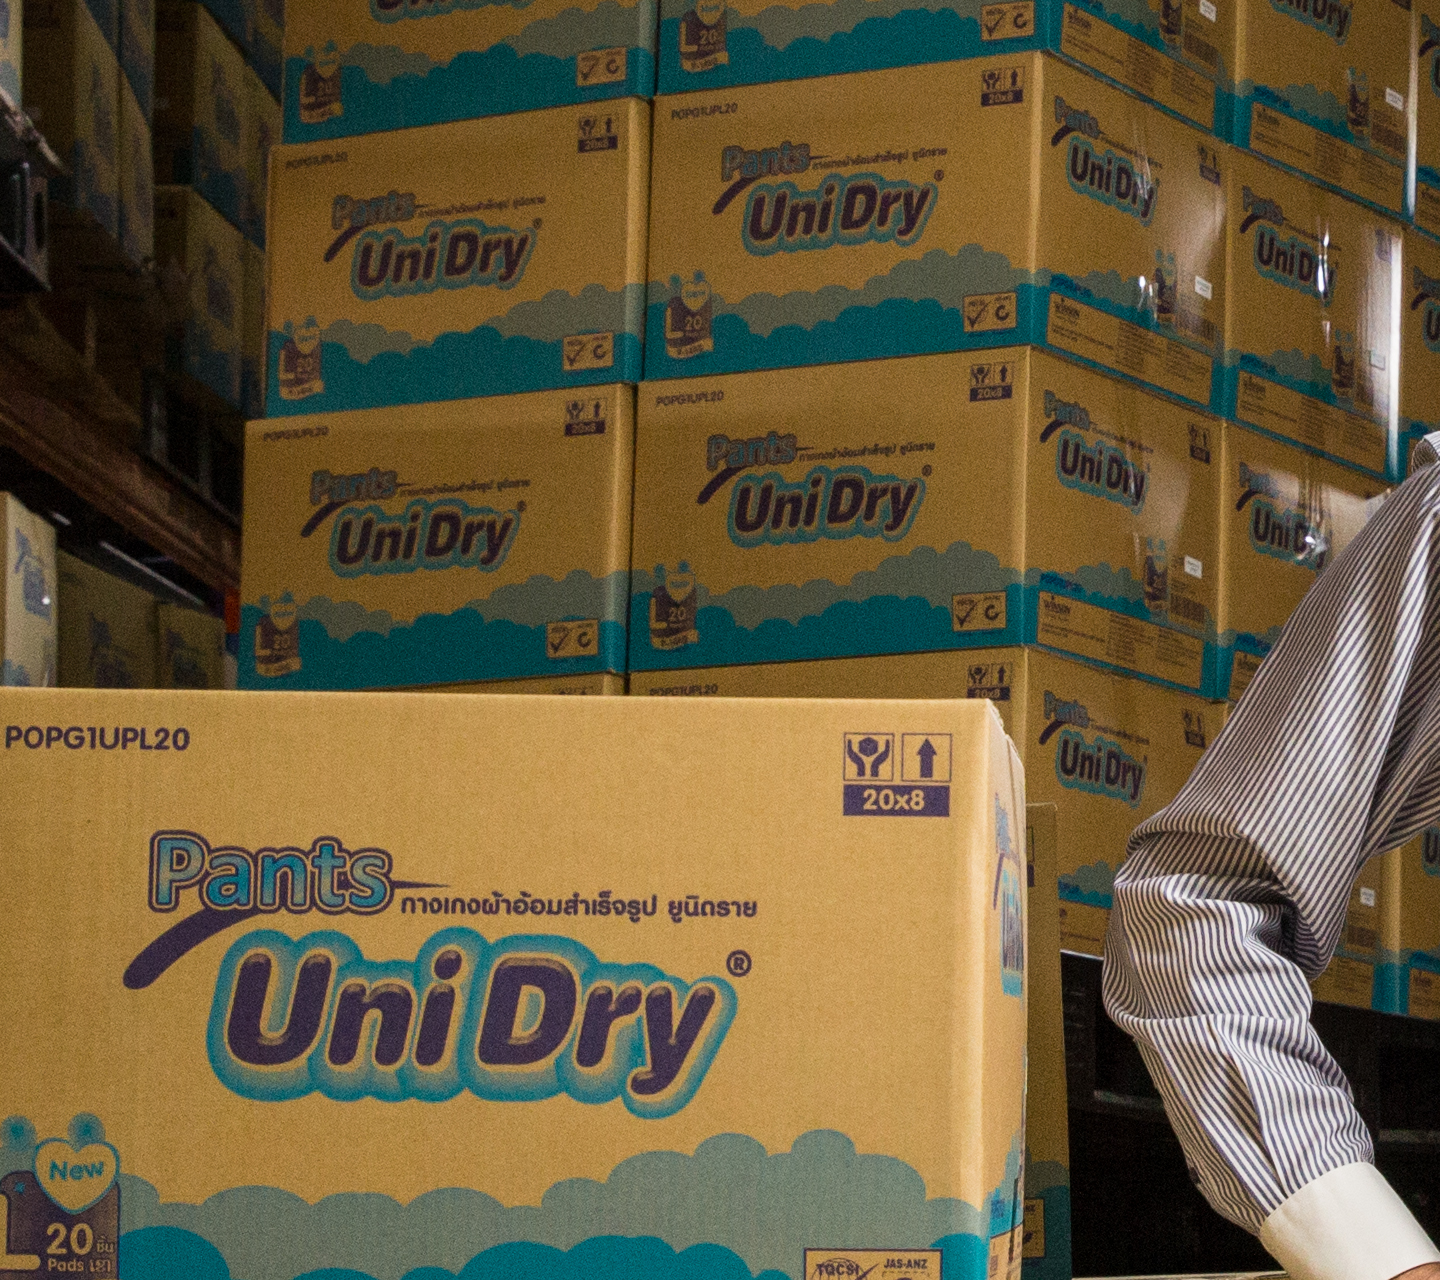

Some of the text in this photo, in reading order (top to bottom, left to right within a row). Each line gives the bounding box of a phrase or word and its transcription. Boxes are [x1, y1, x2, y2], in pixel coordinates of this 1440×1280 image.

[5, 726, 190, 753] POPG1UPL20
[860, 787, 926, 813] 20x8
[148, 829, 393, 915] Pants
[49, 1161, 104, 1181] New
